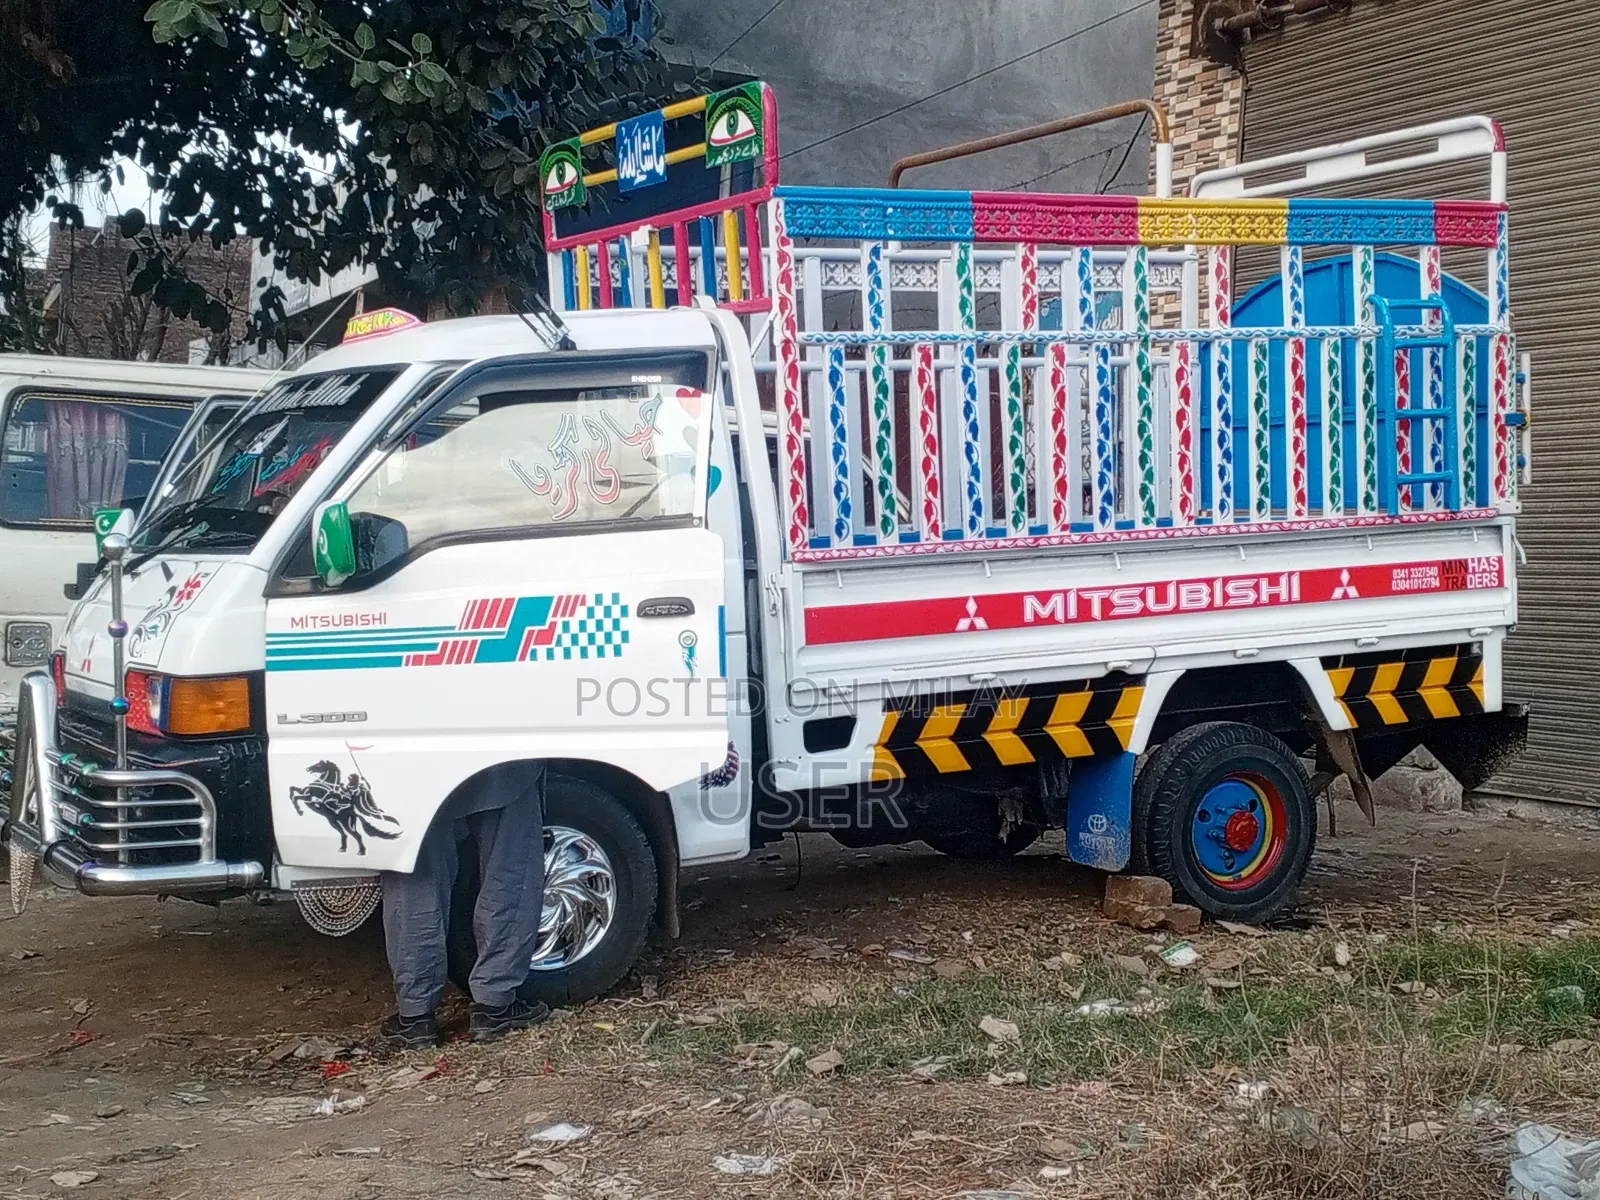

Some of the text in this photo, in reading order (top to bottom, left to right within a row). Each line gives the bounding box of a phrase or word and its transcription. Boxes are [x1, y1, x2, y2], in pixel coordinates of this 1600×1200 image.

[1392, 566, 1439, 579] 0341 3327540
[1023, 571, 1301, 624] MITSUBISHI
[290, 612, 387, 629] MITSUBISHI
[277, 711, 368, 725] L300
